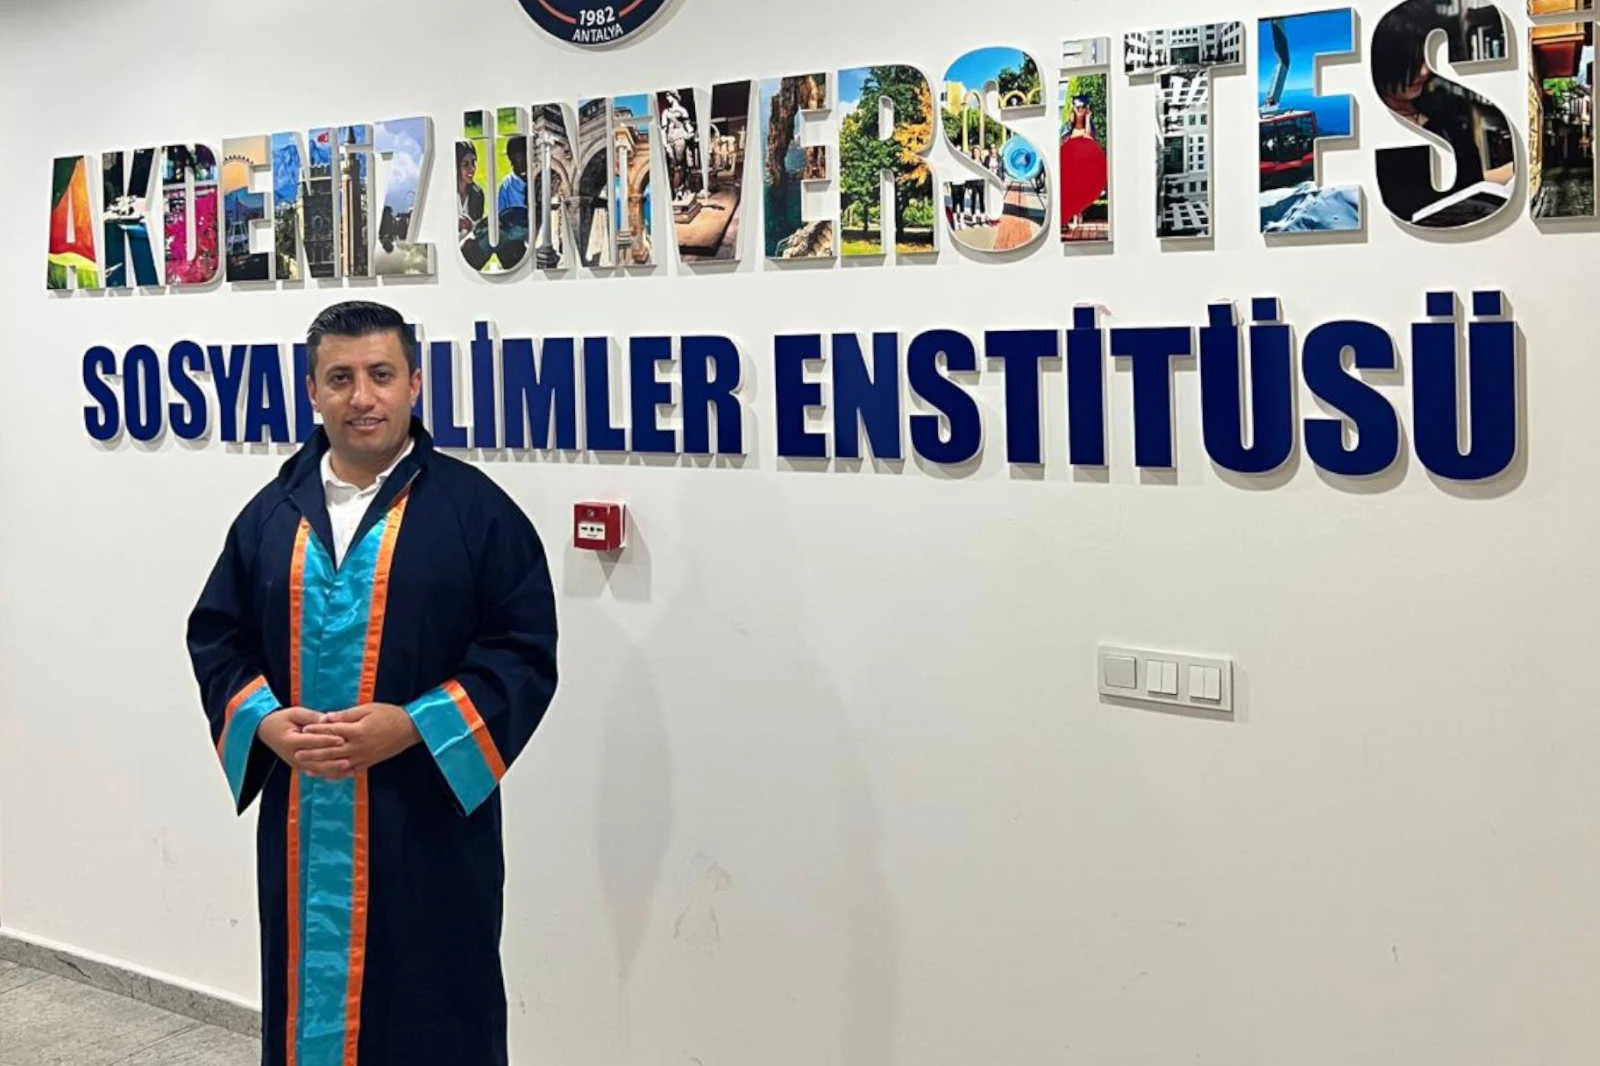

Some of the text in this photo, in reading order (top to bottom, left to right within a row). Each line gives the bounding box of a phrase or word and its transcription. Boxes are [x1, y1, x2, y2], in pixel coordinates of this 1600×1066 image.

[572, 24, 624, 42] ANTALYA
[579, 6, 615, 26] 1982
[47, 117, 431, 290] AKDENİZ
[404, 321, 742, 452] LİMLER
[776, 291, 1516, 480] ENSTİTÜSÜ
